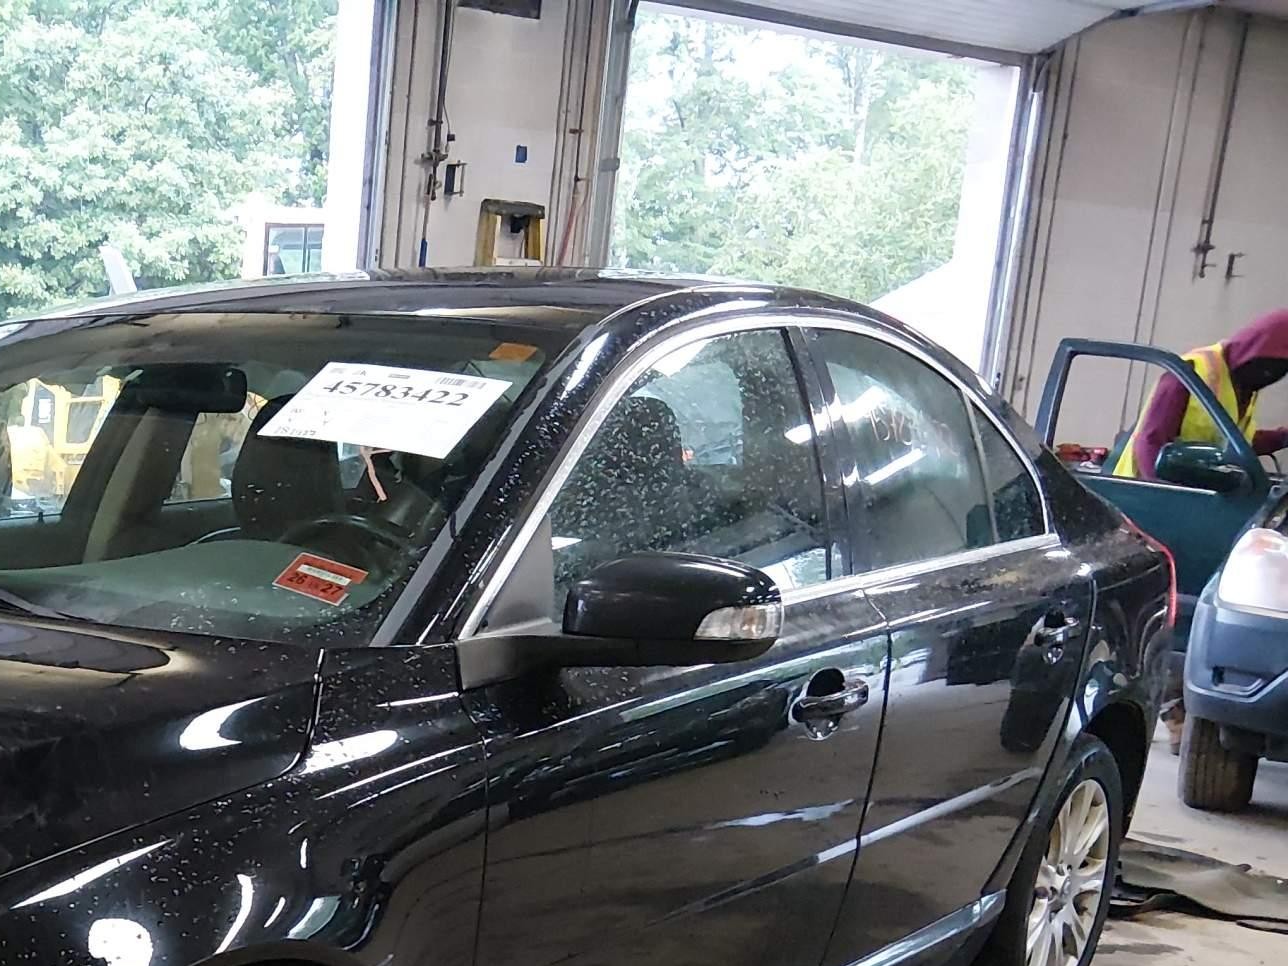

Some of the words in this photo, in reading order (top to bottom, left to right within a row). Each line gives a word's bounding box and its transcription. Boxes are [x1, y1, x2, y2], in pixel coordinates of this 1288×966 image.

[323, 380, 470, 407] 45783422
[287, 572, 308, 585] 26
[320, 583, 343, 595] 27
